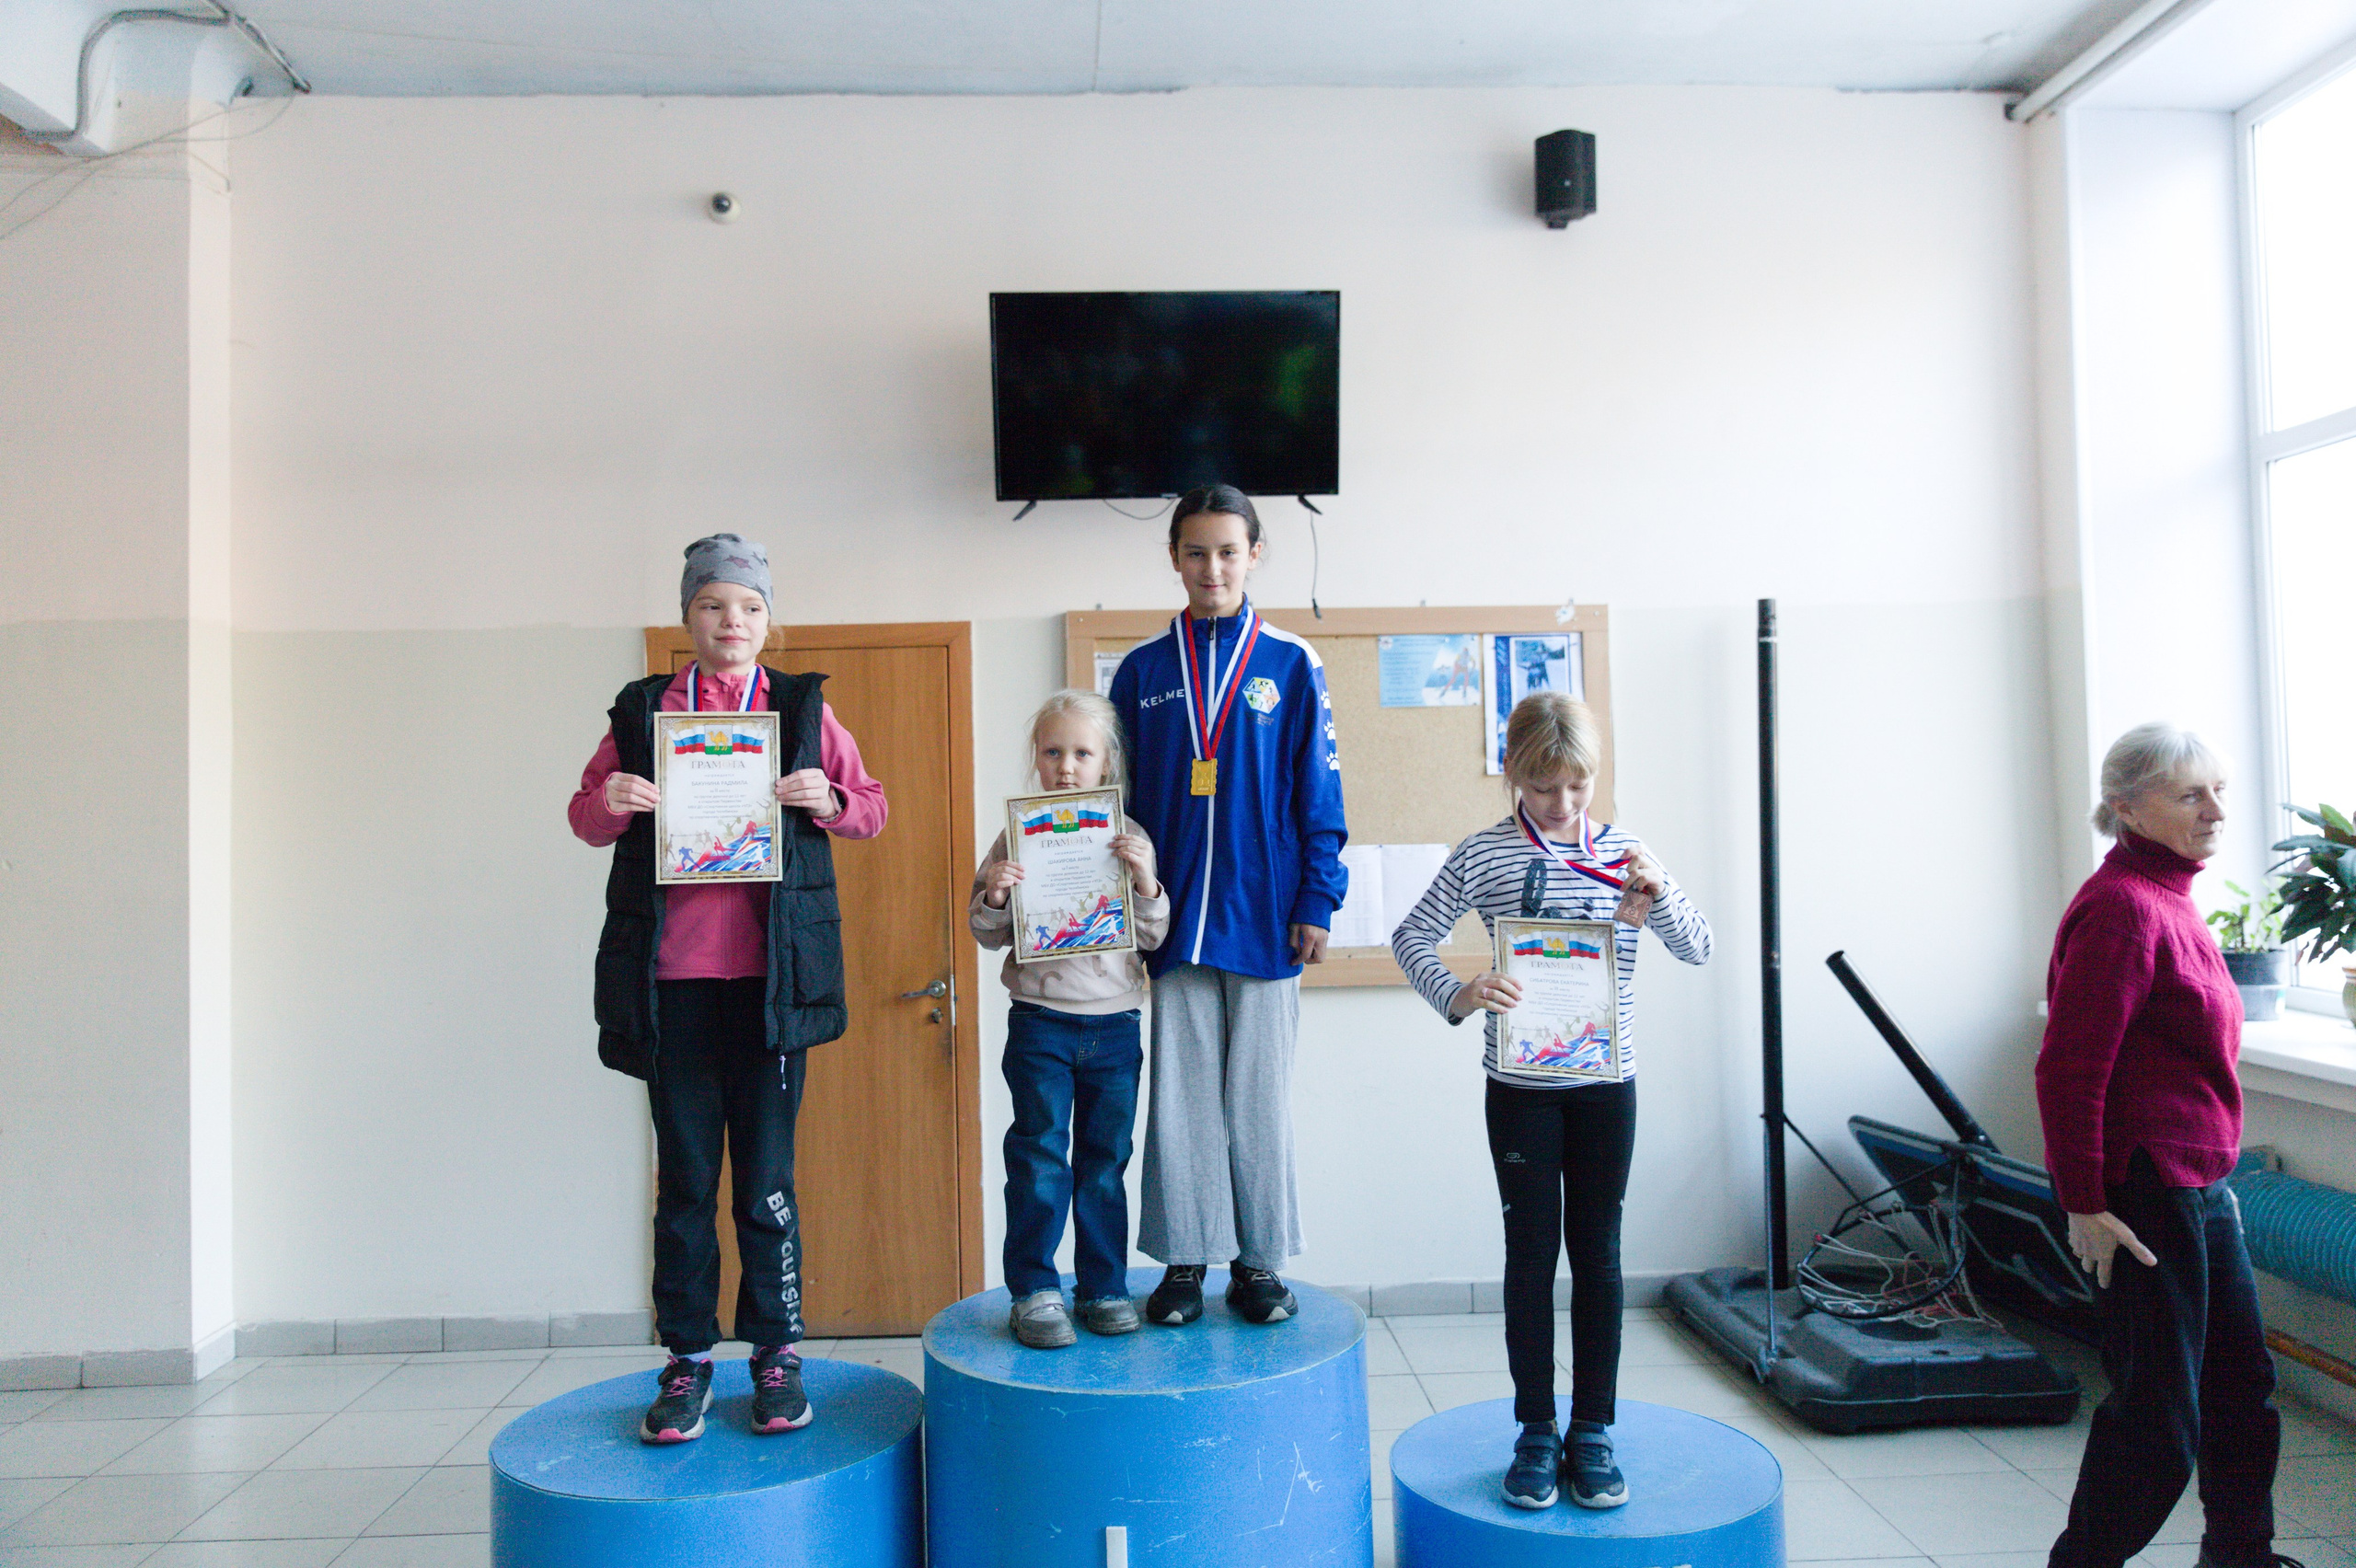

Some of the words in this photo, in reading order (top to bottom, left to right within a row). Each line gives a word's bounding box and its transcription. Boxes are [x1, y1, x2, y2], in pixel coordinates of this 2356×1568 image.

[1140, 688, 1185, 709] KELME
[691, 760, 745, 769] ГРАМОТА
[1041, 836, 1092, 847] ГРАМОТА
[1047, 857, 1077, 865] ШАКИРОВА
[1530, 961, 1584, 971] ГРАМОТА
[766, 1191, 791, 1227] BE
[781, 1227, 803, 1334] OURSLF
